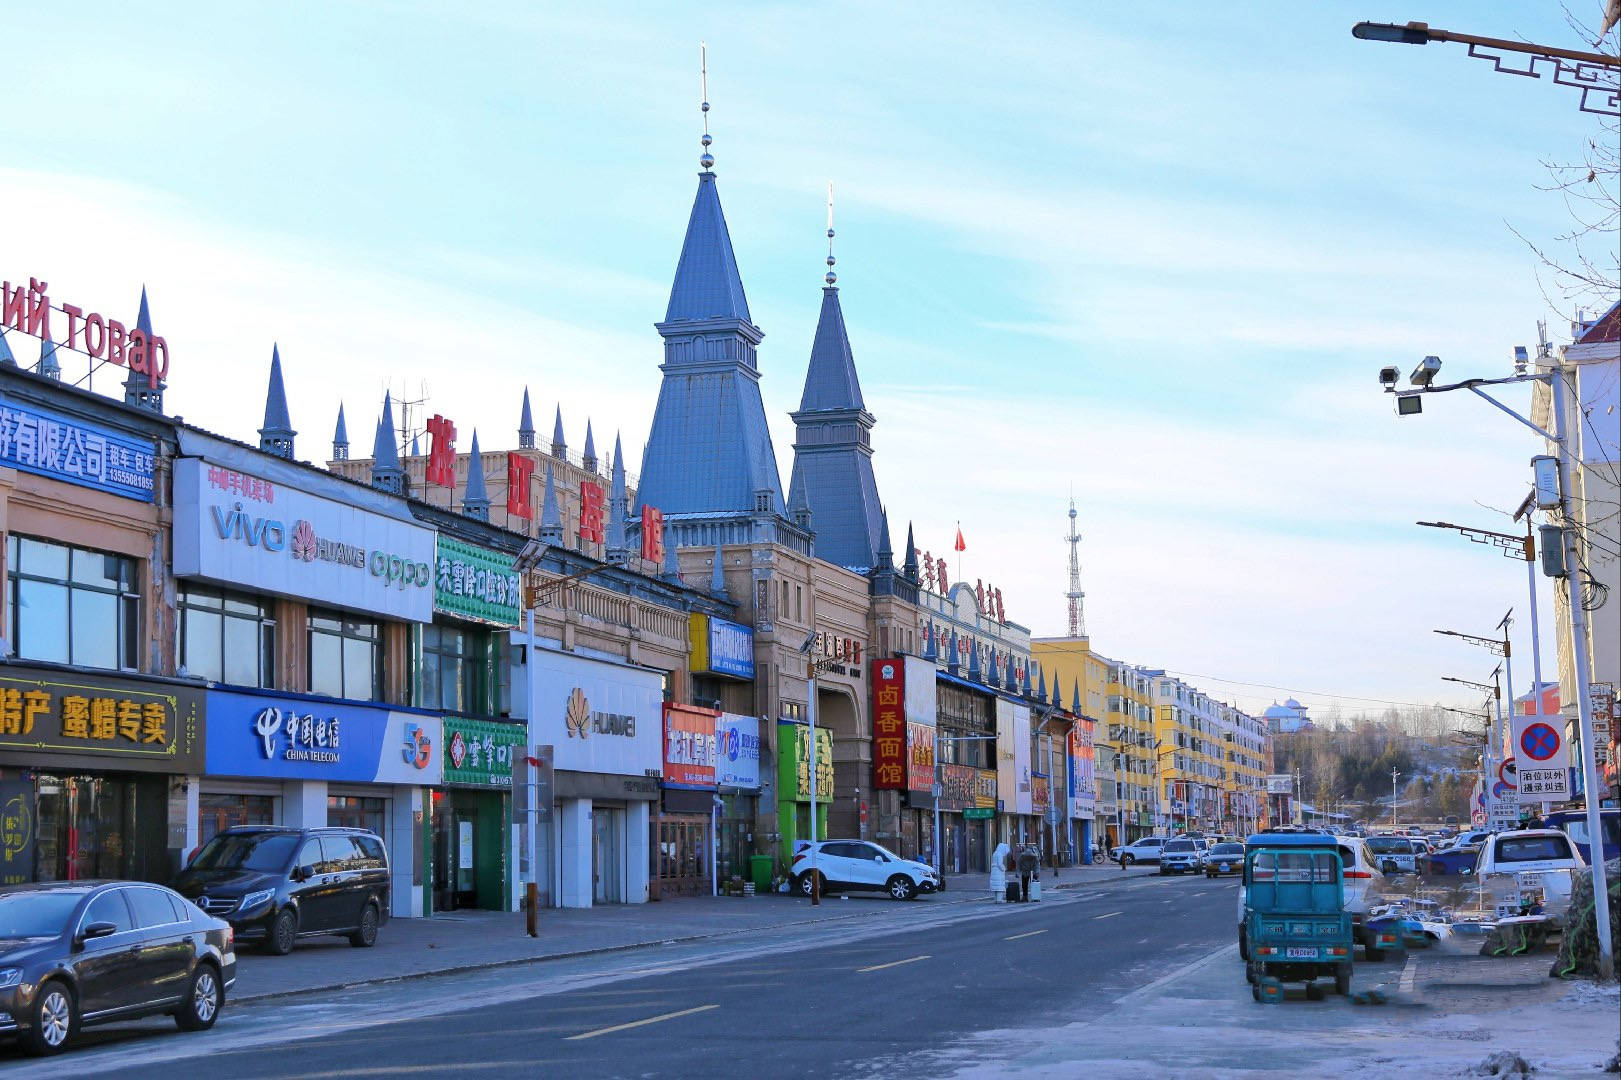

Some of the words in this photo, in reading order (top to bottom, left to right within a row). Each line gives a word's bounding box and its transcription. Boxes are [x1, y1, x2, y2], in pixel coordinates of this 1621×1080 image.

[286, 710, 340, 749] 中国电信
[592, 710, 636, 738] HUAWEI
[877, 684, 902, 784] 卤香面馆
[286, 749, 309, 761] CHINA
[310, 750, 340, 763] TELECOM
[1523, 771, 1564, 781] 泊位以外
[1523, 782, 1565, 793] 摄录纠违
